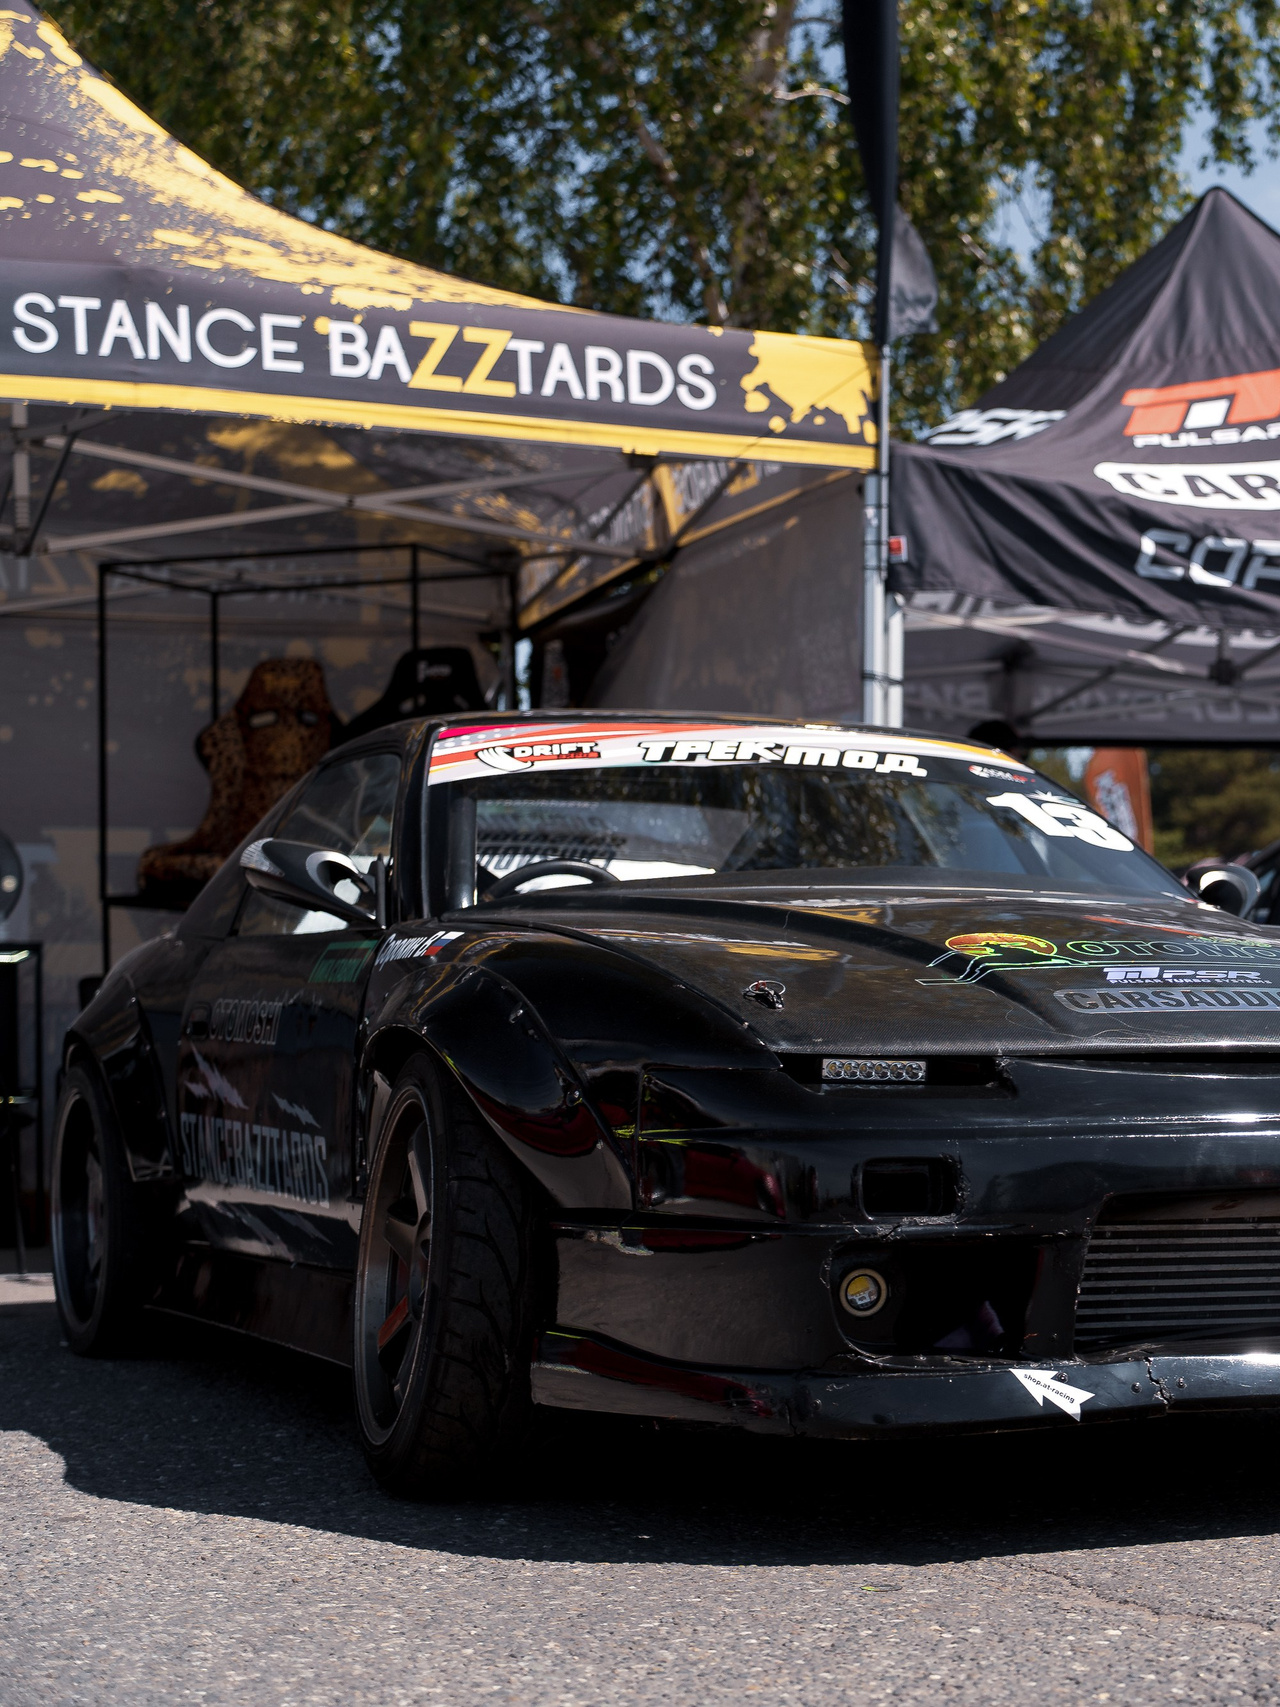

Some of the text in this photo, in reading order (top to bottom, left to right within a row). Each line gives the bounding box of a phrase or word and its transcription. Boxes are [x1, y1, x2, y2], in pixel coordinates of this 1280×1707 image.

[13, 292, 717, 411] STANCE BAZZTARDS
[513, 742, 598, 758] DRIFT
[985, 791, 1134, 853] 13
[1162, 969, 1261, 980] PSR
[1024, 1374, 1075, 1404] shop.at-racing
